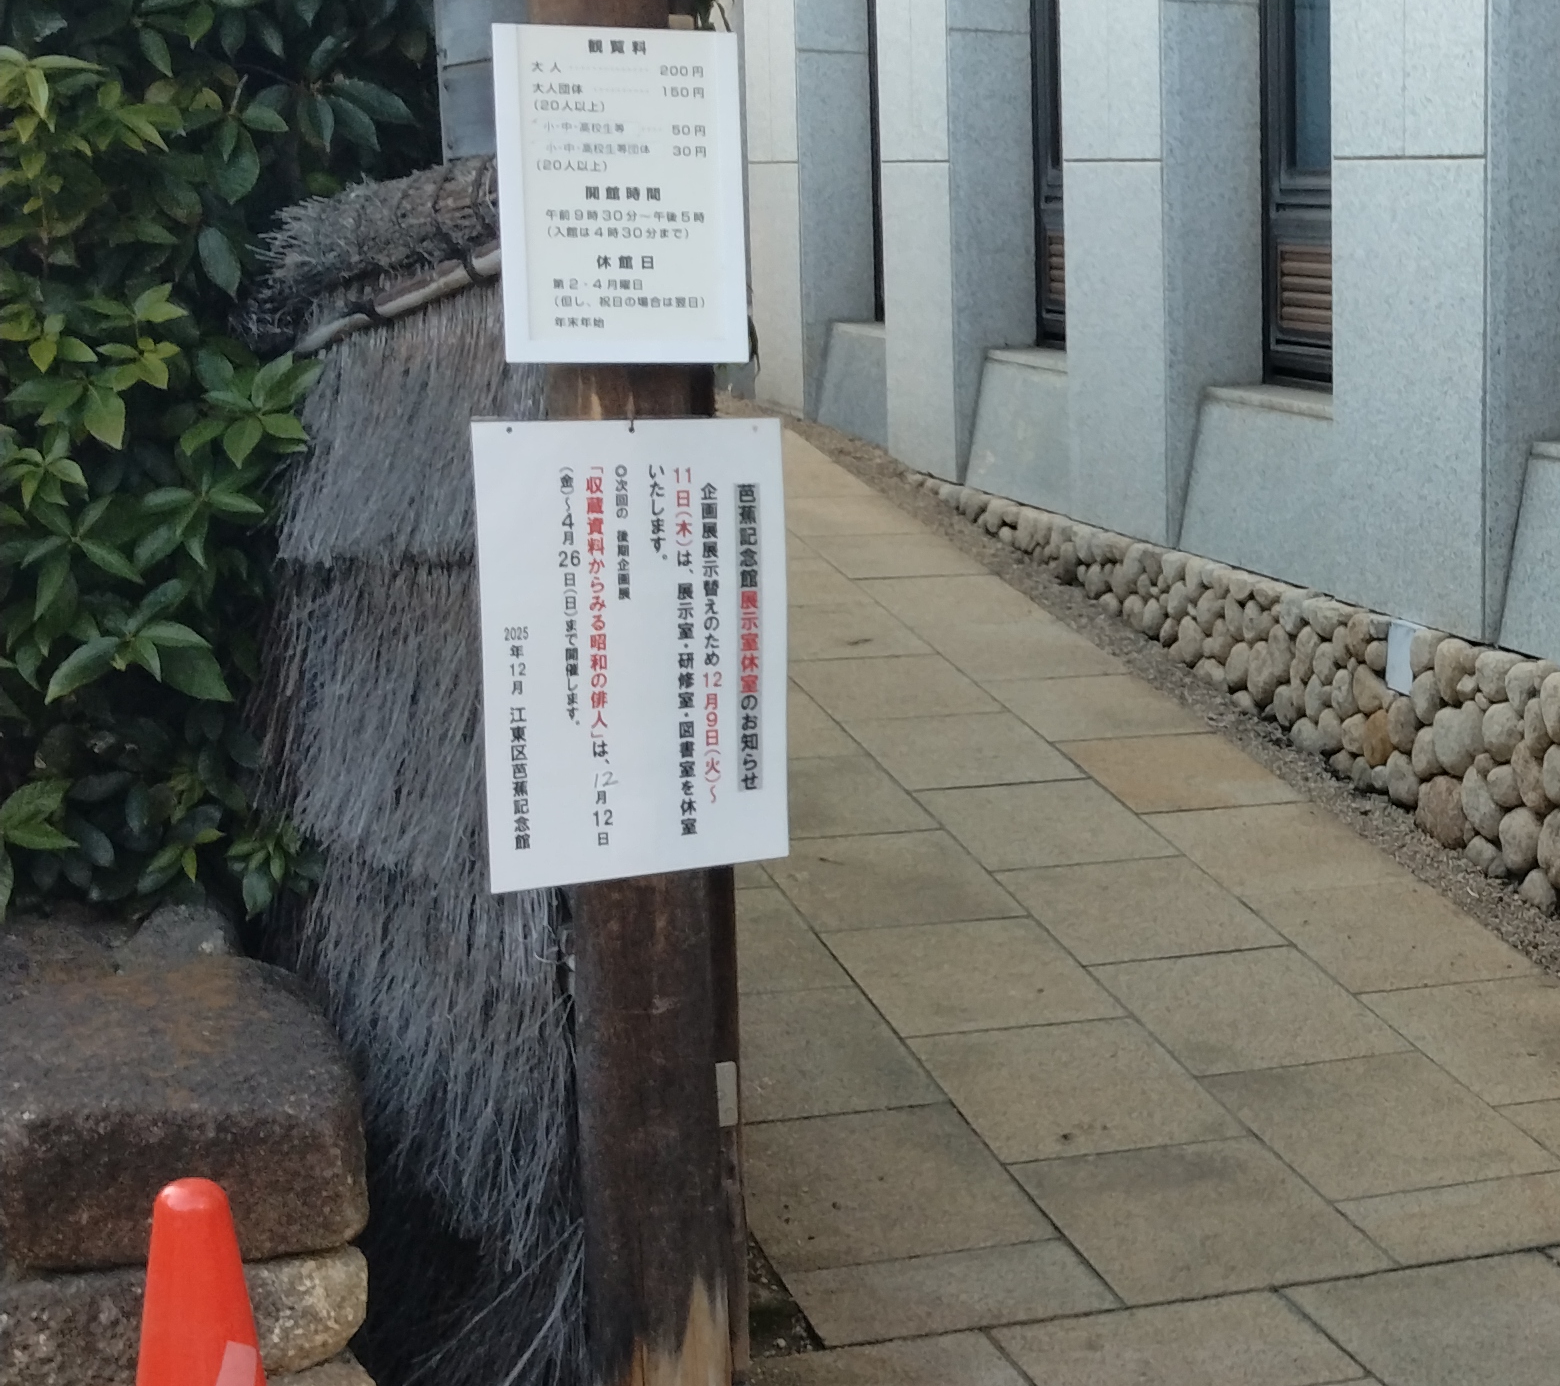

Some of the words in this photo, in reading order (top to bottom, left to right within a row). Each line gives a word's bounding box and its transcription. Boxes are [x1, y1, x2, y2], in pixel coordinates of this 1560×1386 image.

[588, 38, 647, 55] 観覧料
[659, 64, 704, 78] 200円
[532, 82, 583, 95] 大人団体
[662, 86, 705, 99] 150円
[671, 124, 706, 137] 50円
[672, 145, 707, 158] 30円
[585, 185, 661, 201] 開館時間
[596, 254, 655, 270] 休館日
[554, 316, 605, 329] 年末年始
[648, 463, 668, 561] いたします。
[737, 483, 760, 791] 芭蕉記念館展示室休室のお知らせ
[509, 706, 531, 851] 江東区芭蕉記念館
